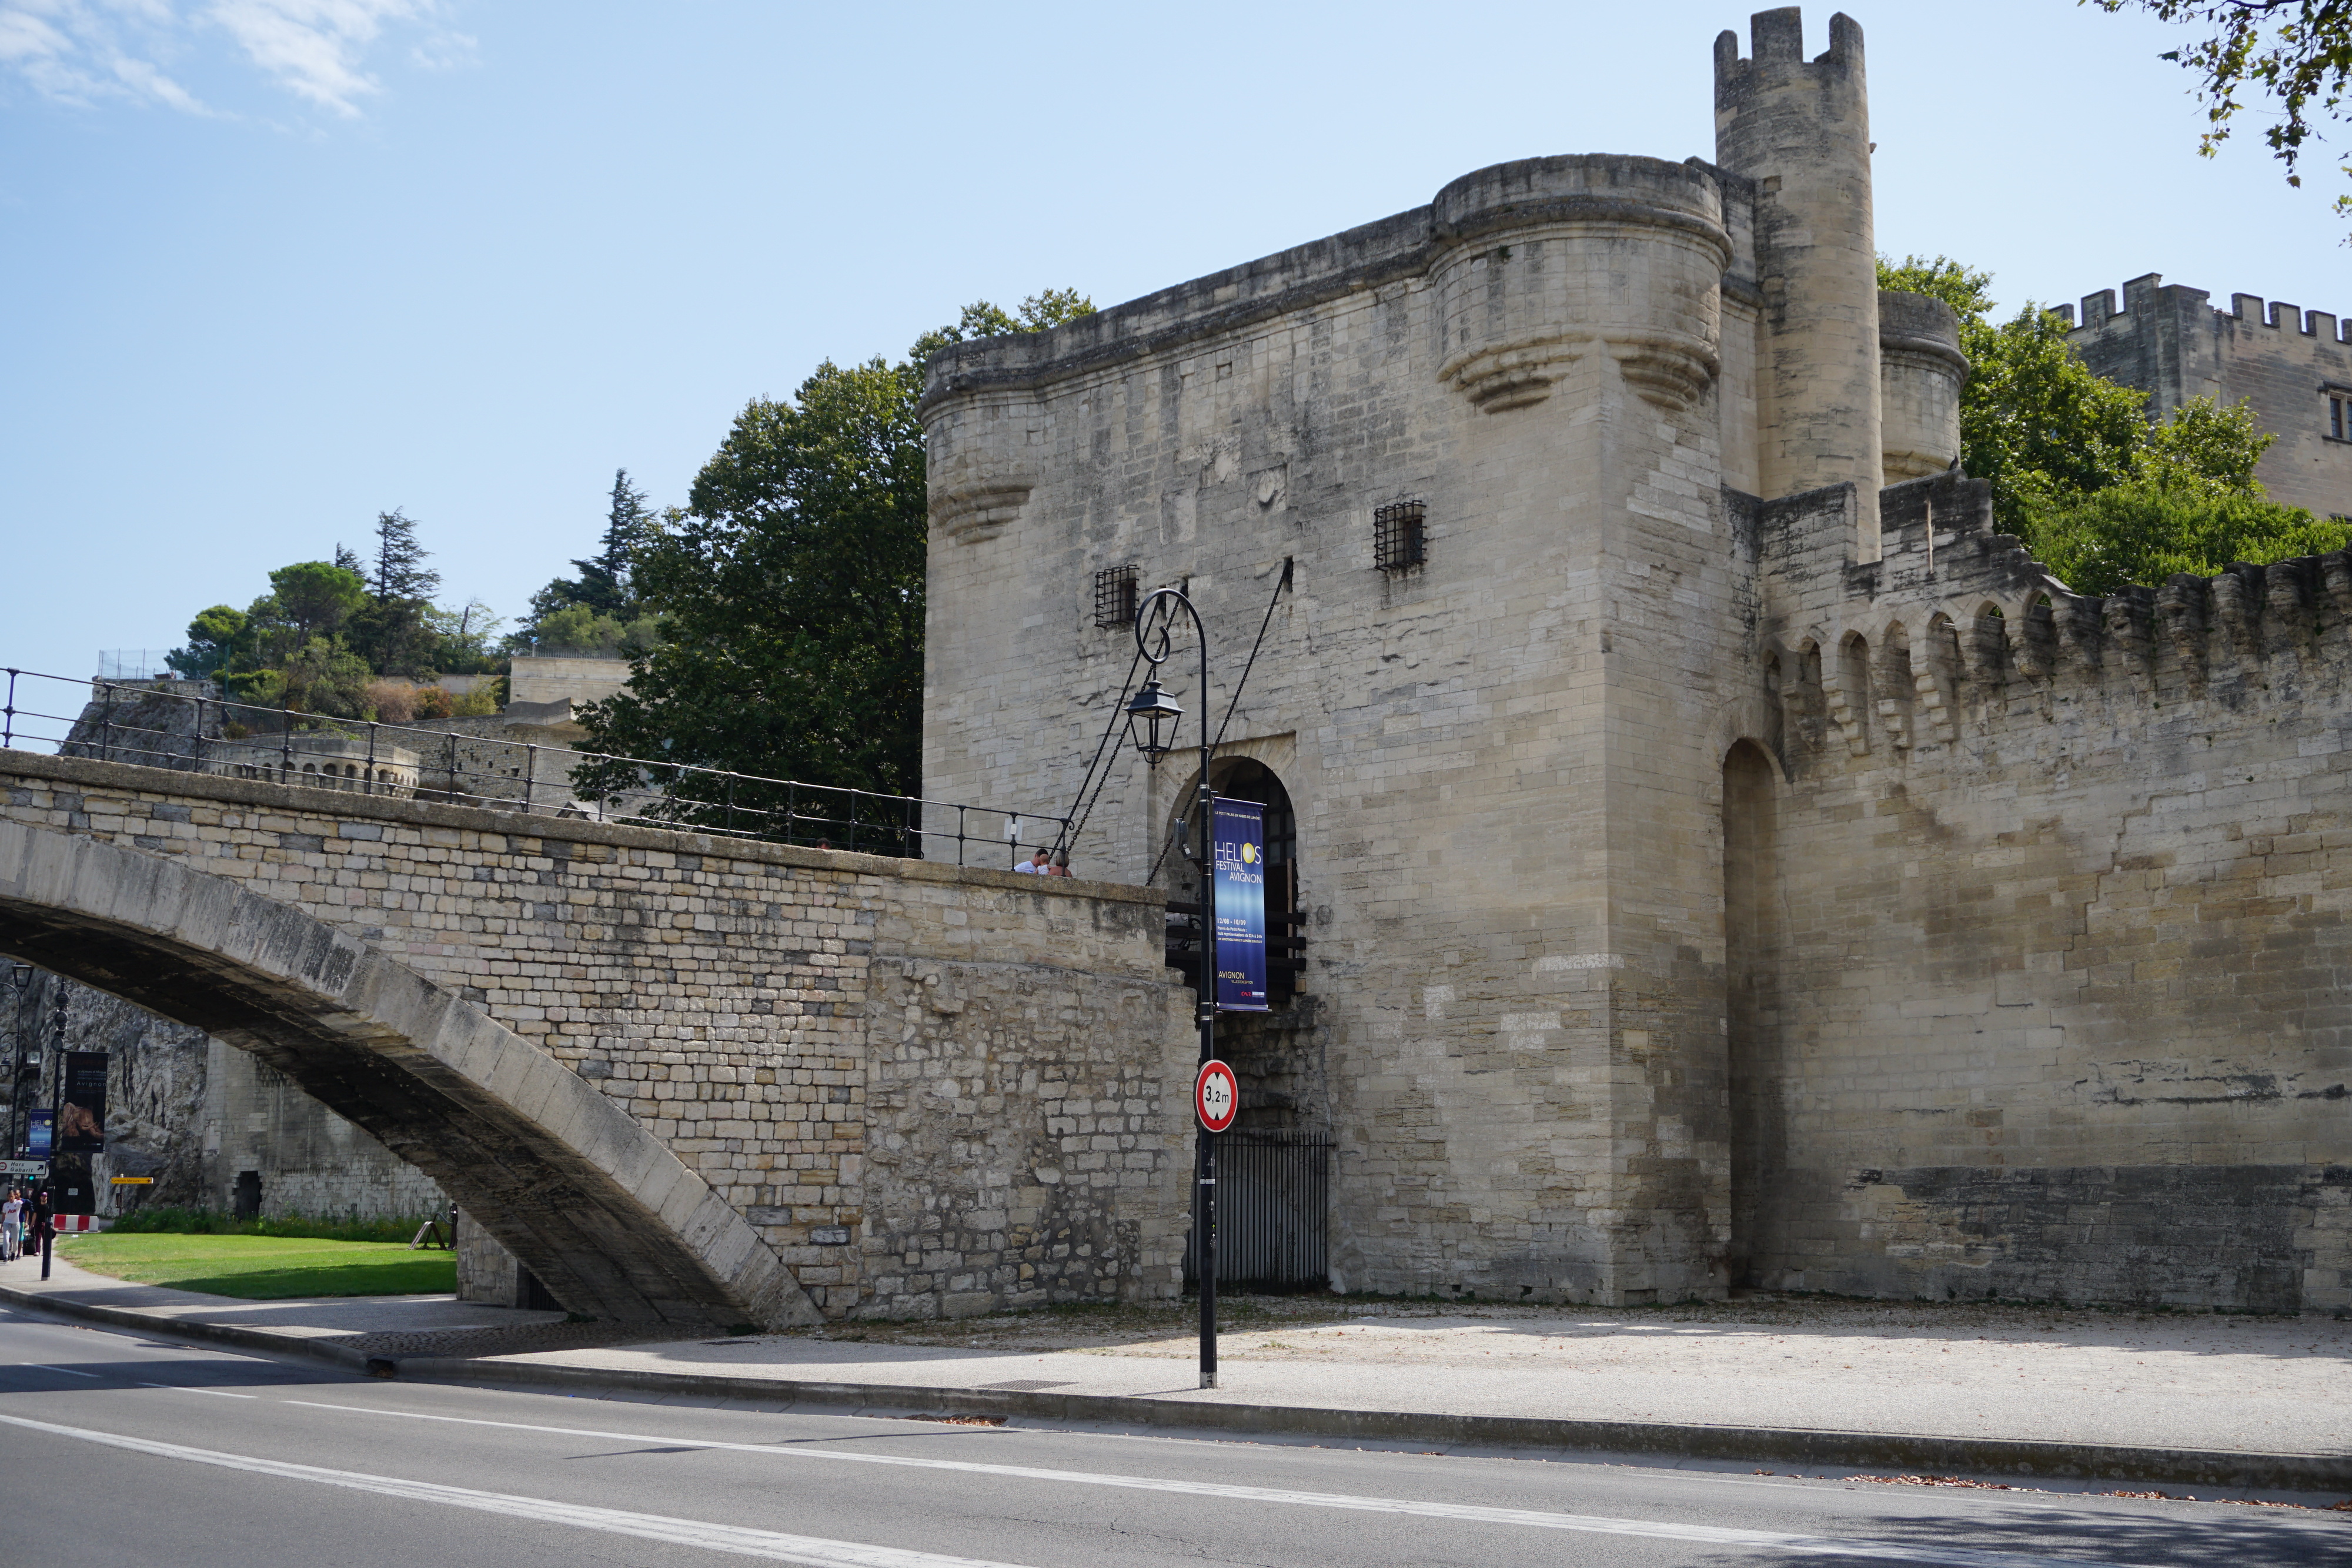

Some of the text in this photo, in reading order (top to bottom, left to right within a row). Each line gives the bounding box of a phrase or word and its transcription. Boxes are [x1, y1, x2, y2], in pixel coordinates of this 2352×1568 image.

[1215, 841, 1261, 864] HELIOS
[1216, 860, 1245, 872] FESTIVAL
[1230, 871, 1262, 884] AVIGNON
[1218, 971, 1245, 979] AVIGNON
